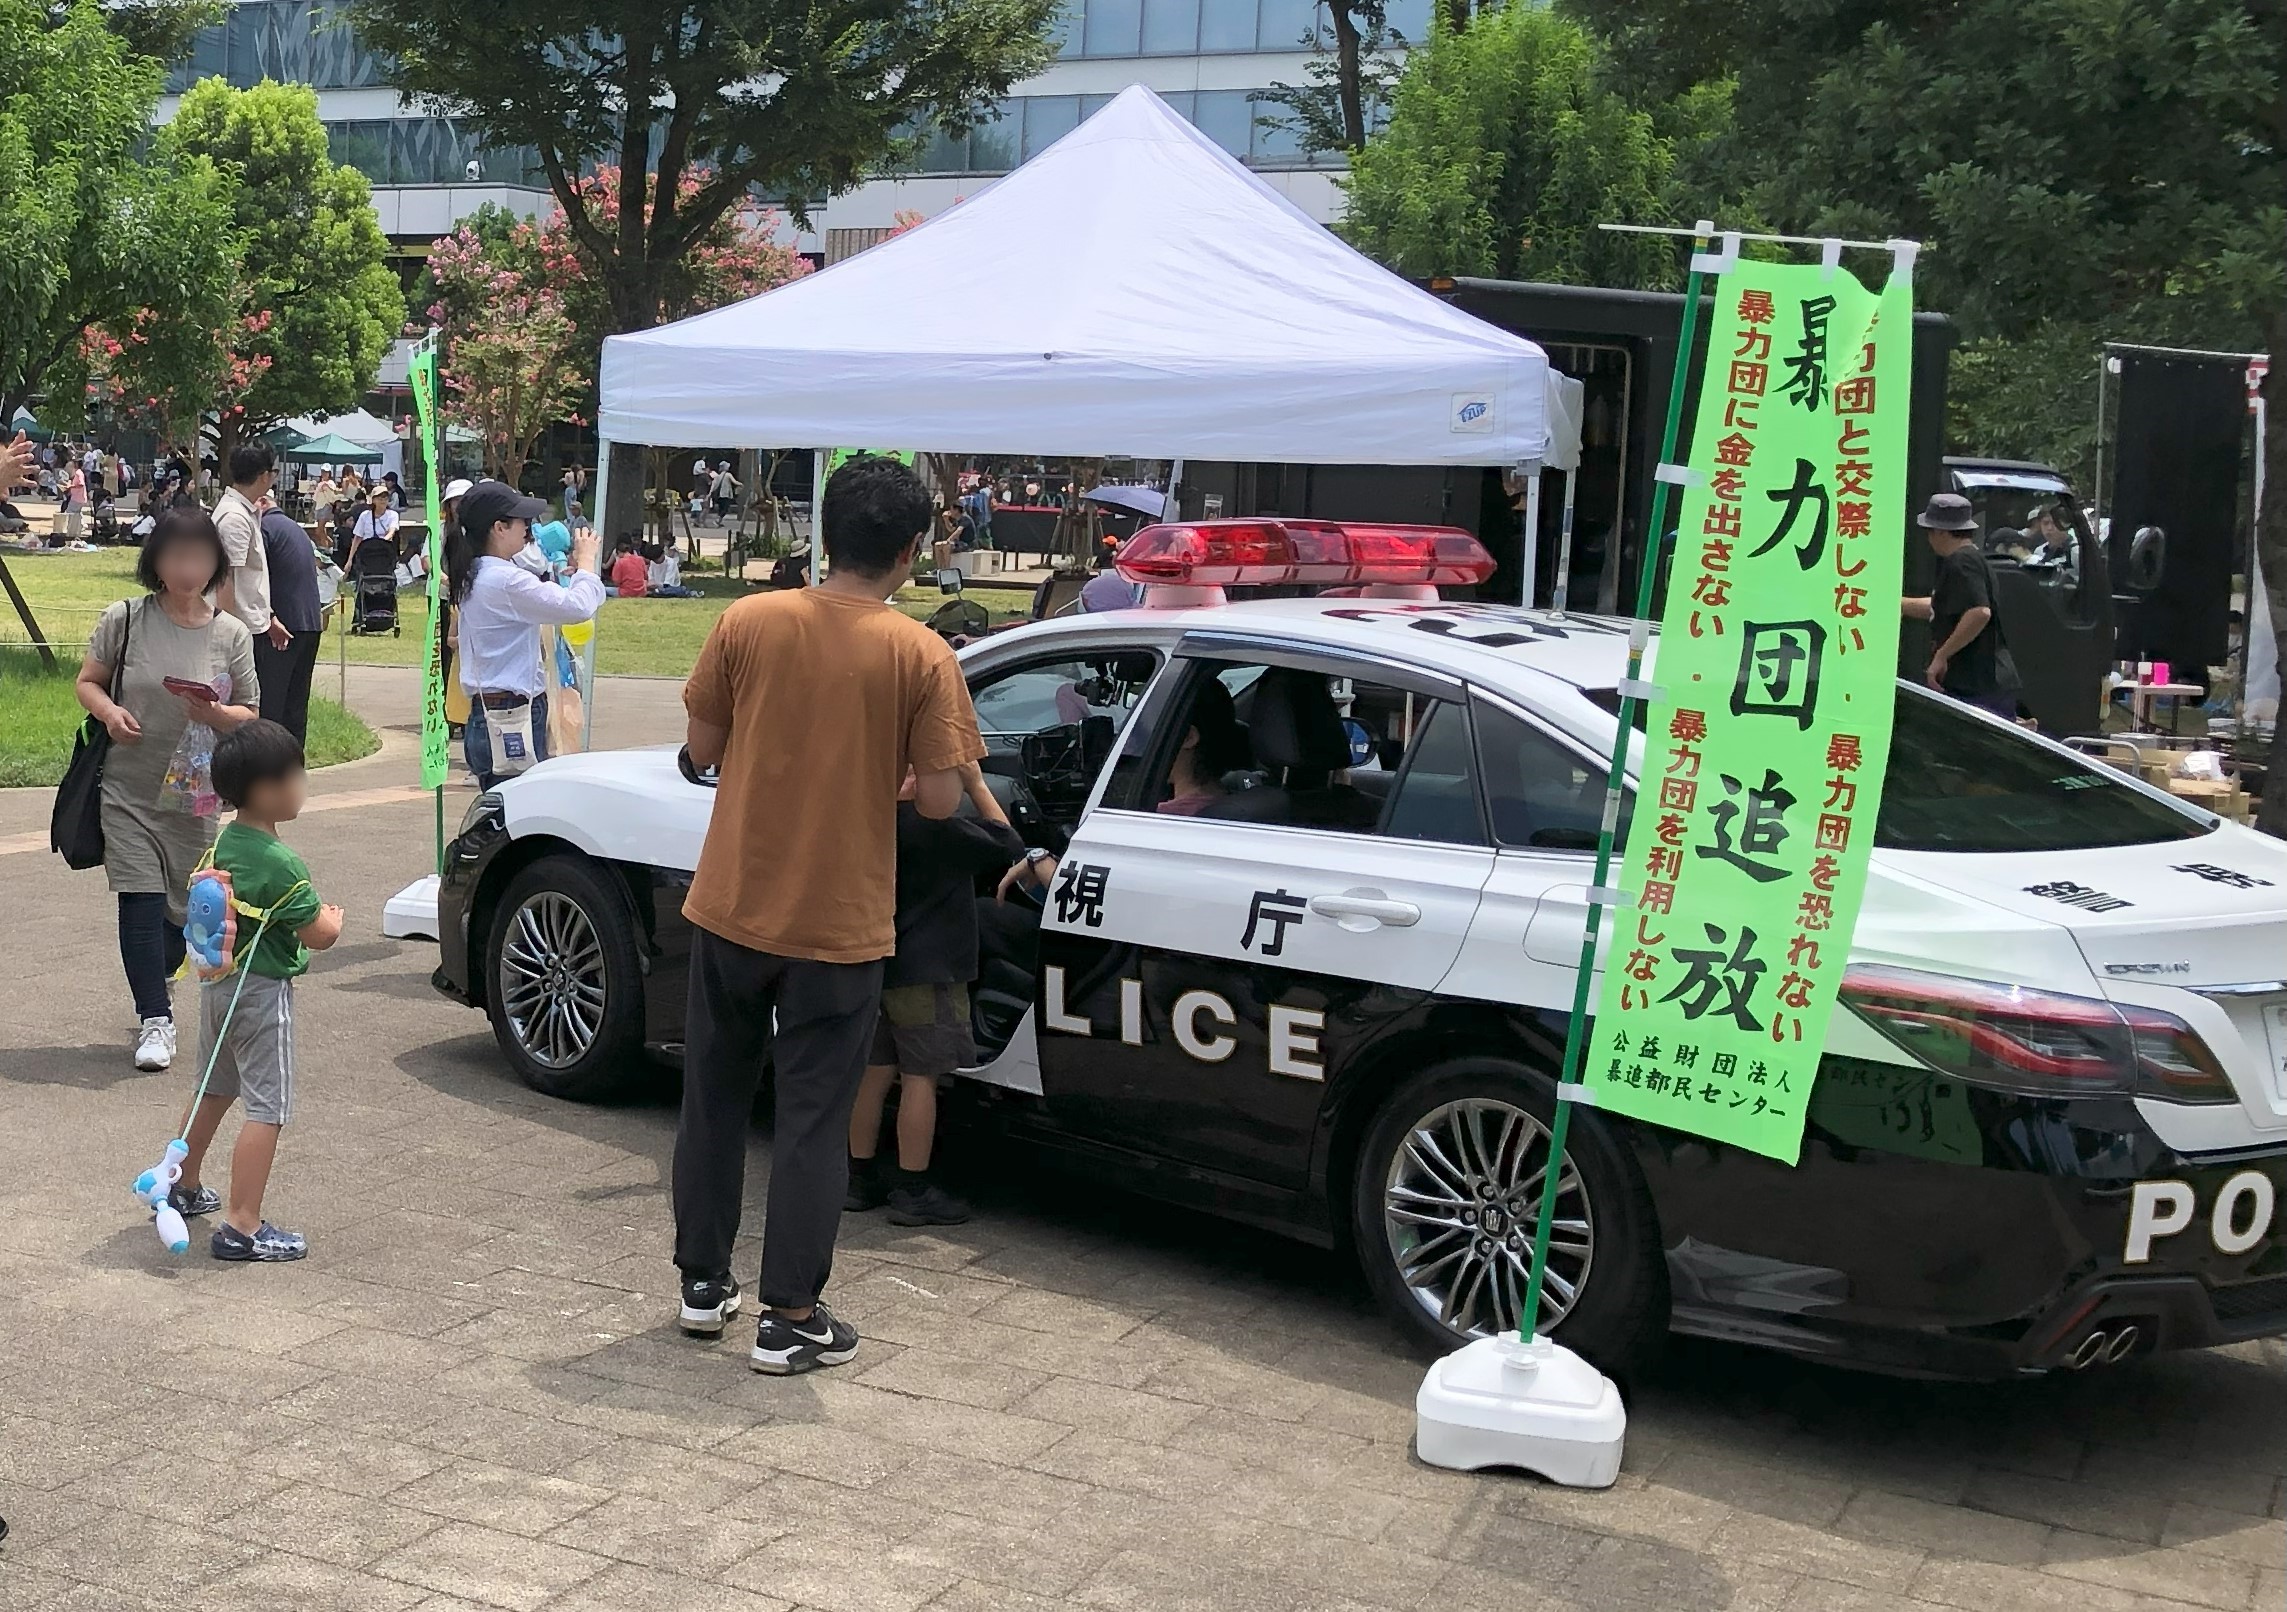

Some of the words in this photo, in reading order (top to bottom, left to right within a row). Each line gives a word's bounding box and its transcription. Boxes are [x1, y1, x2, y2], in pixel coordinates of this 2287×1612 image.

[1656, 295, 1837, 1031] 暴力団追放
[1613, 1029, 1791, 1093] 公益財団法人
